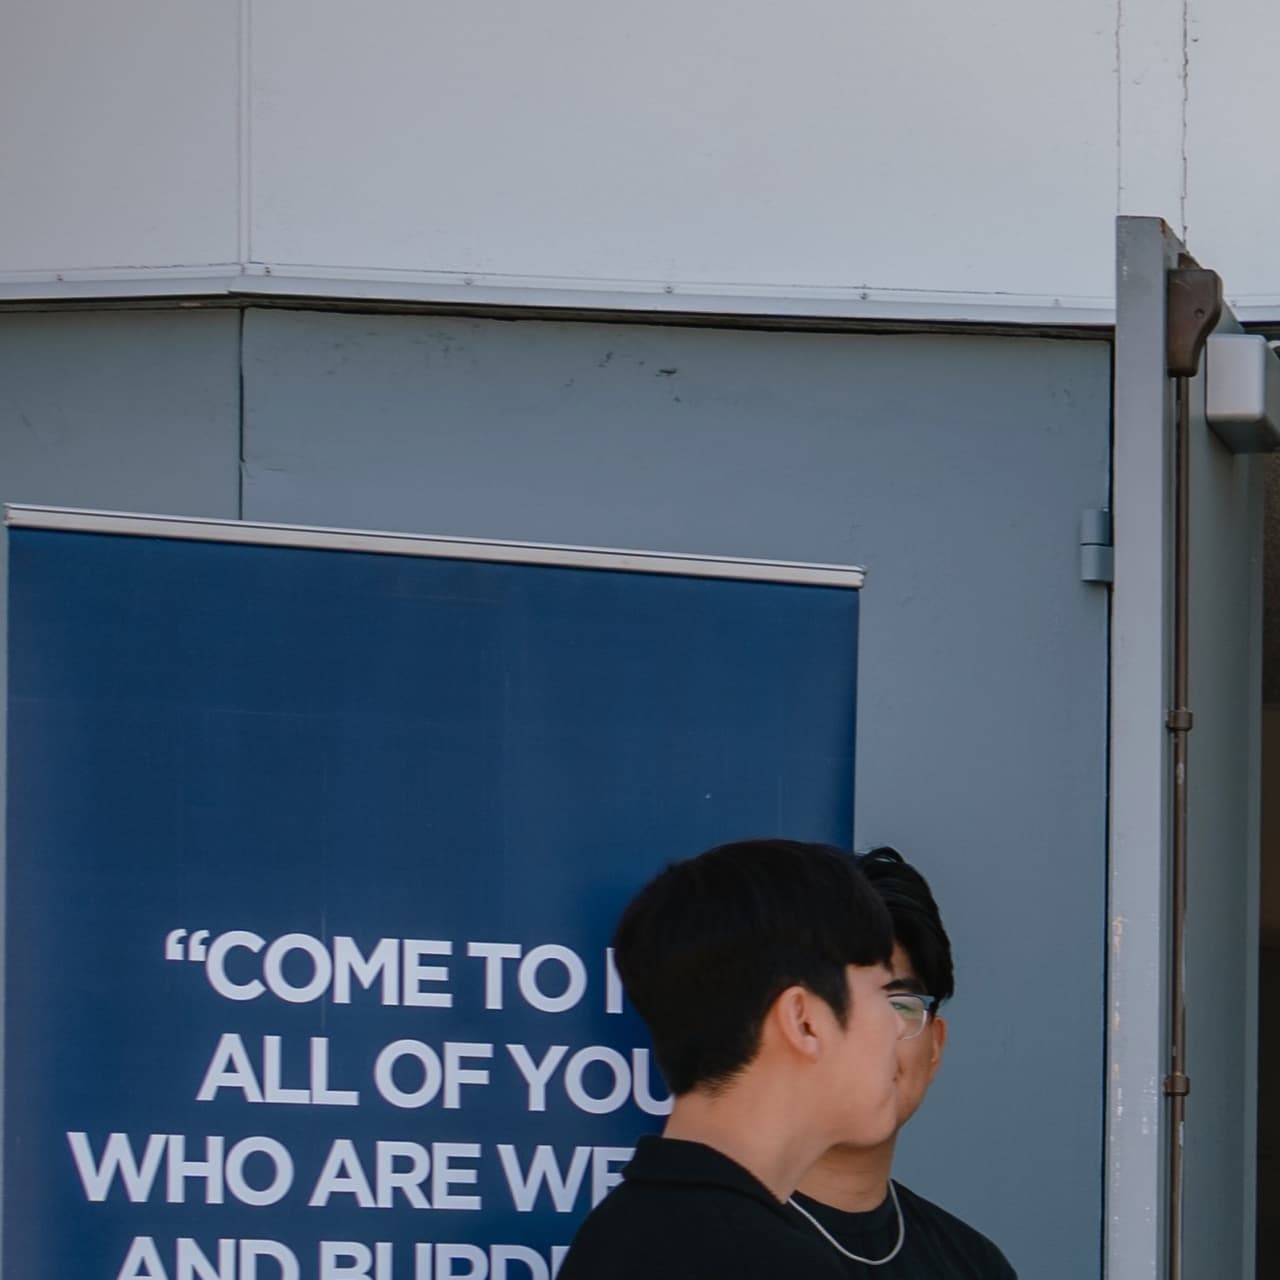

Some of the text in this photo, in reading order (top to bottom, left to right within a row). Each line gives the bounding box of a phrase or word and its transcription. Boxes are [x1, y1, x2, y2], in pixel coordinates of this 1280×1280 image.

[164, 928, 454, 1009] “COME
[466, 941, 588, 1013] TO
[195, 1032, 674, 1116] ALL OF YOU
[66, 1131, 636, 1213] WHO ARE WE
